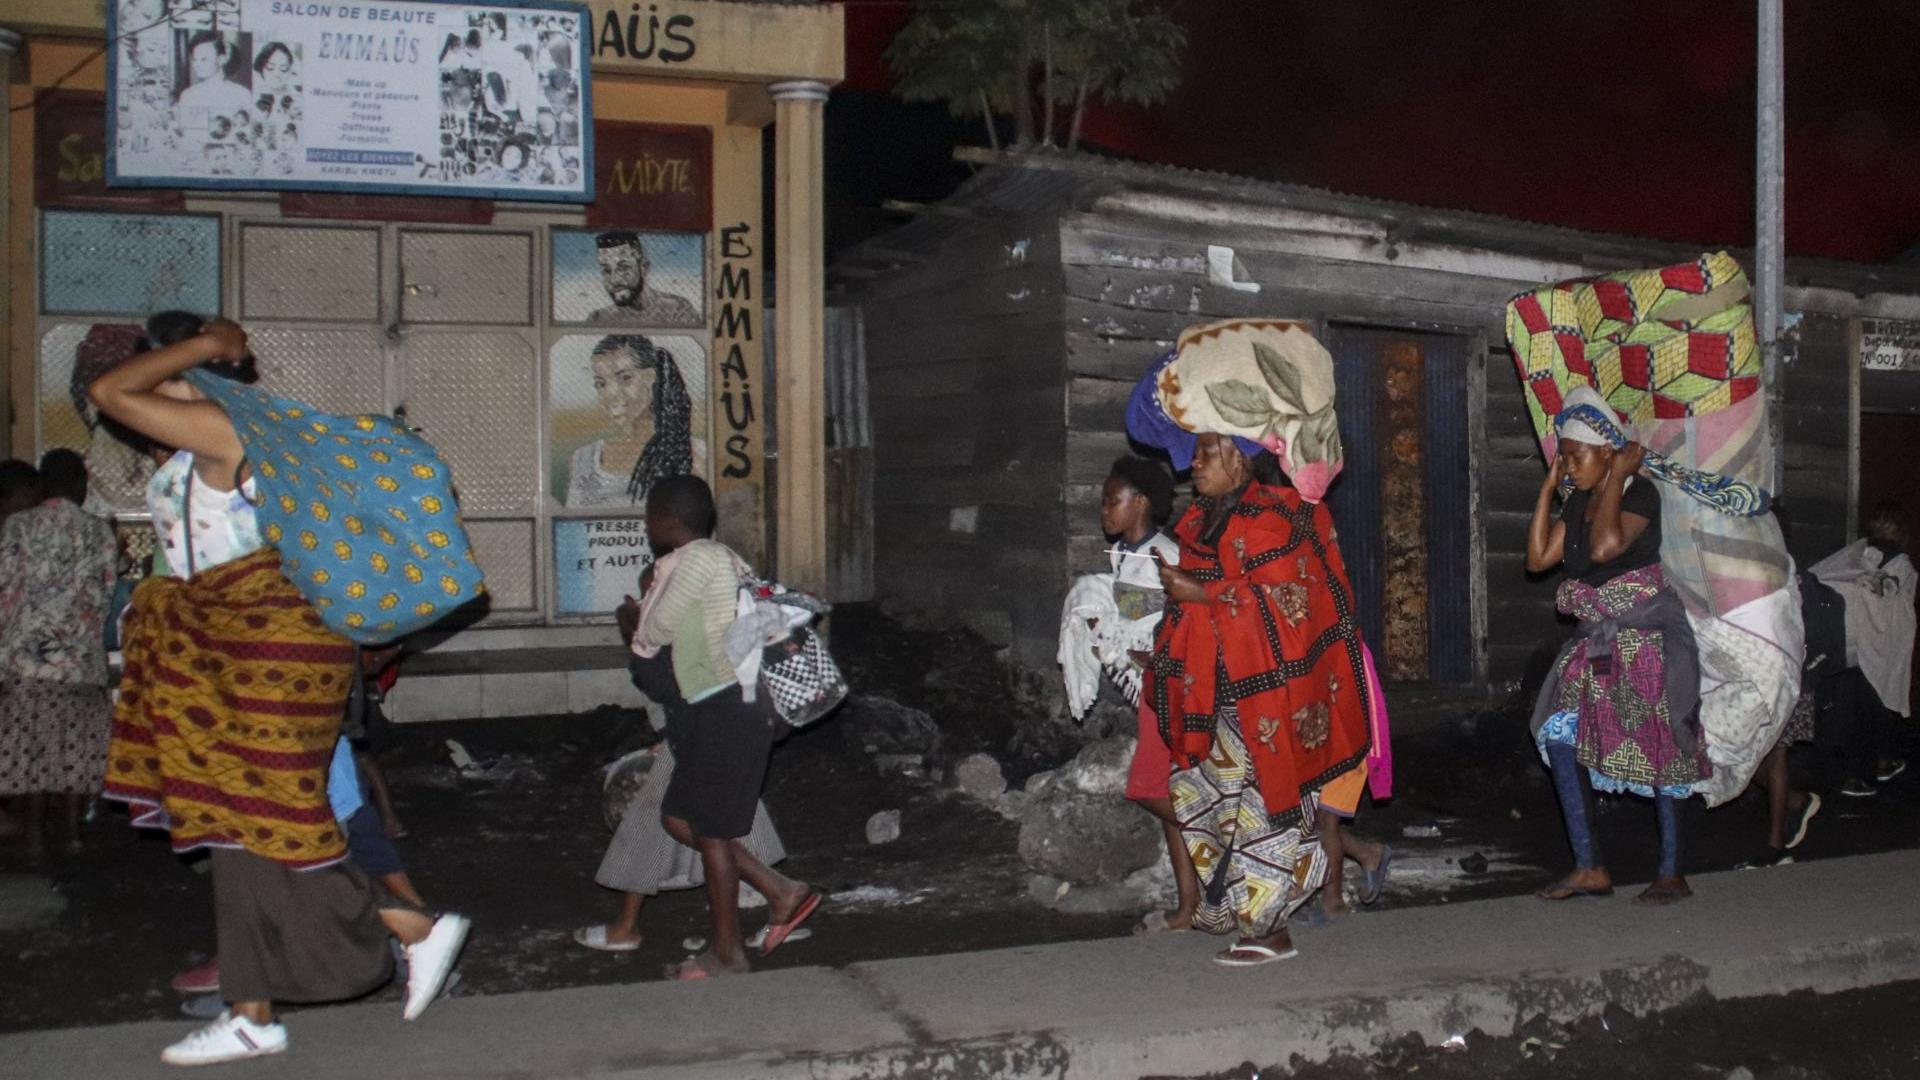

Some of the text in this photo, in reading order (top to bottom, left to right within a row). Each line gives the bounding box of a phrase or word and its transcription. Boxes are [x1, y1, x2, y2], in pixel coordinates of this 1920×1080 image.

[271, 1, 437, 25] SALON DE BEAUTE
[587, 3, 696, 63] AÜS
[318, 28, 421, 65] EMMAÜS
[714, 221, 756, 480] EMMAÜS
[584, 521, 648, 533] TRESSE
[588, 536, 645, 548] PRODUI
[577, 554, 652, 571] ET AUTR
